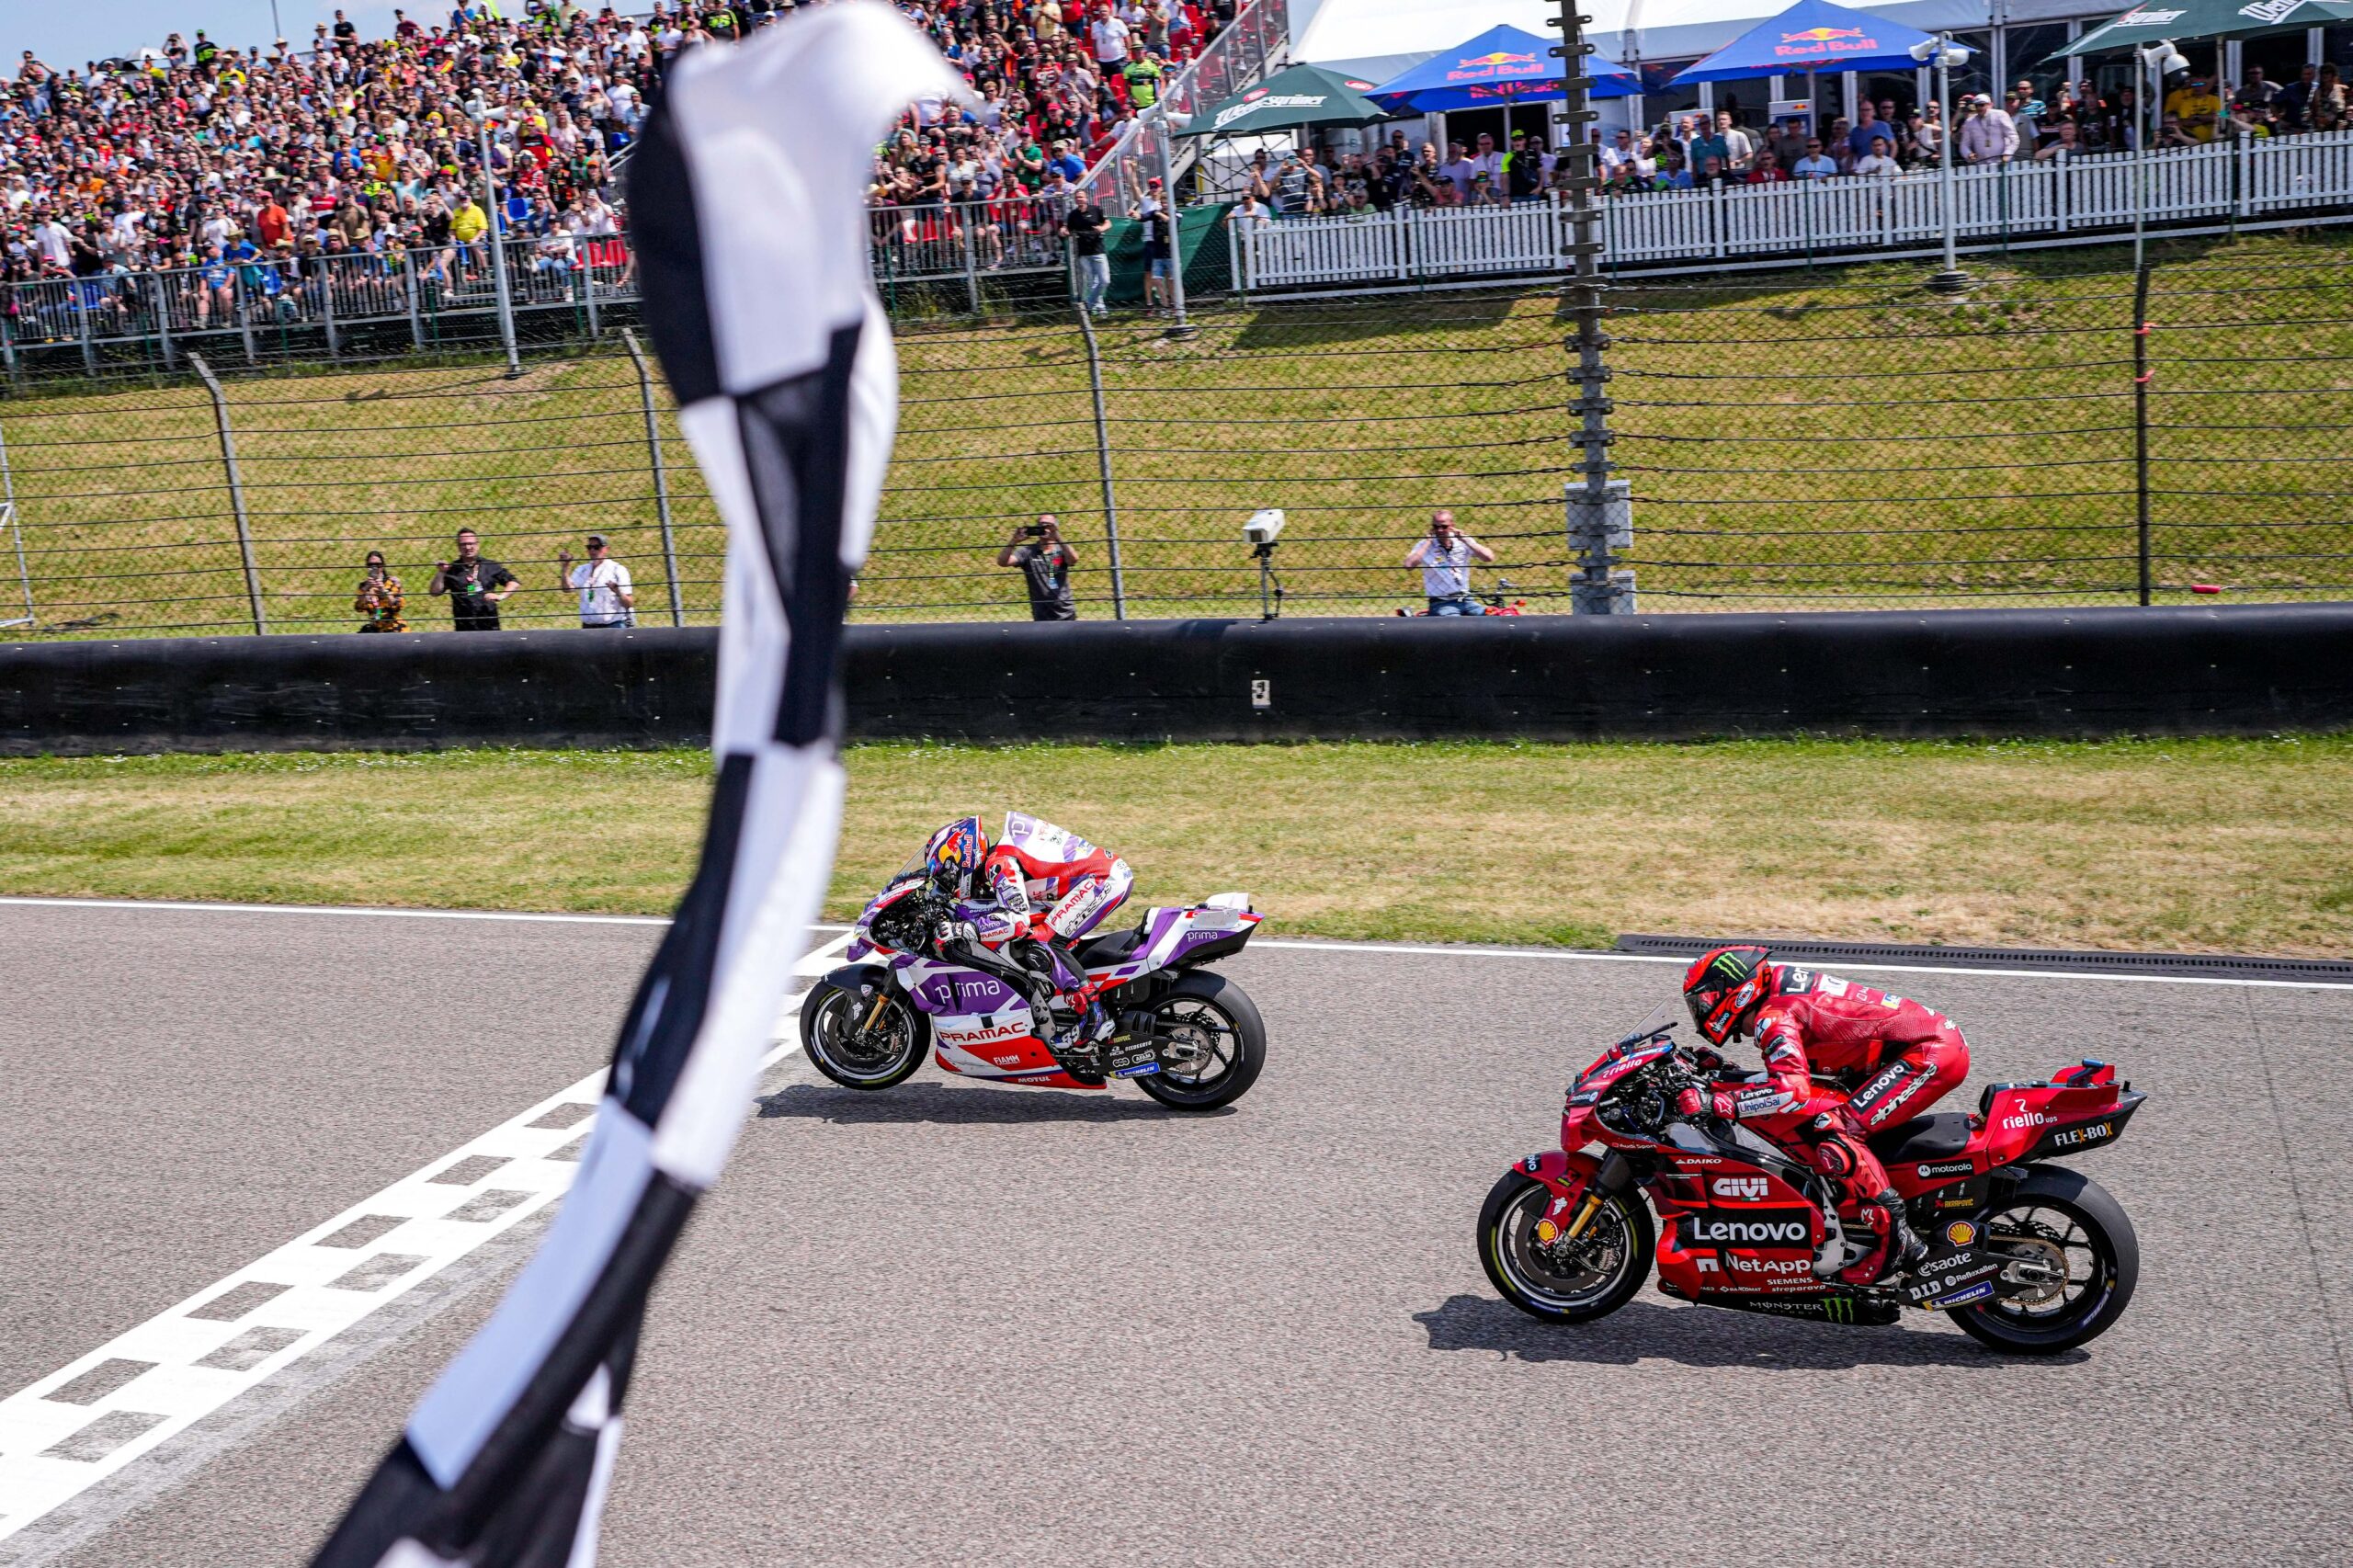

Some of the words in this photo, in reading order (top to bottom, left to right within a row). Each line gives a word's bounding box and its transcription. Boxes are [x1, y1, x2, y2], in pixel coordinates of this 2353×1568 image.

[1774, 41, 1825, 56] Red
[1827, 39, 1878, 52] Bull
[1446, 65, 1495, 81] Red
[1496, 63, 1545, 75] Bull
[1051, 881, 1095, 926] PRAMAC
[1186, 931, 1218, 942] prima
[935, 980, 1001, 1005] prima
[939, 1022, 1026, 1042] PRAMAC
[993, 1054, 1020, 1065] FIAMM
[1609, 1058, 1643, 1076] riello
[1124, 1066, 1154, 1076] MICHELIN
[1740, 1088, 1773, 1100] Lenovo
[1853, 1064, 1904, 1108] Lenovo
[1739, 1096, 1780, 1113] UnipolSai
[2002, 1113, 2044, 1130] riello
[2045, 1115, 2058, 1124] ups
[2054, 1122, 2114, 1147] FLEX-BOX
[1931, 1163, 1973, 1174] motorola
[1712, 1177, 1769, 1198] GIVI
[1693, 1217, 1807, 1241] Lenovo
[1724, 1252, 1812, 1275] NetApp
[1917, 1252, 1972, 1278] esaote
[1767, 1277, 1813, 1286] SIEMENS
[1956, 1263, 1999, 1283] Reflexallen
[1771, 1284, 1826, 1293] streparava
[1944, 1286, 1986, 1305] MICHELIN
[1749, 1301, 1824, 1312] MONSTER
